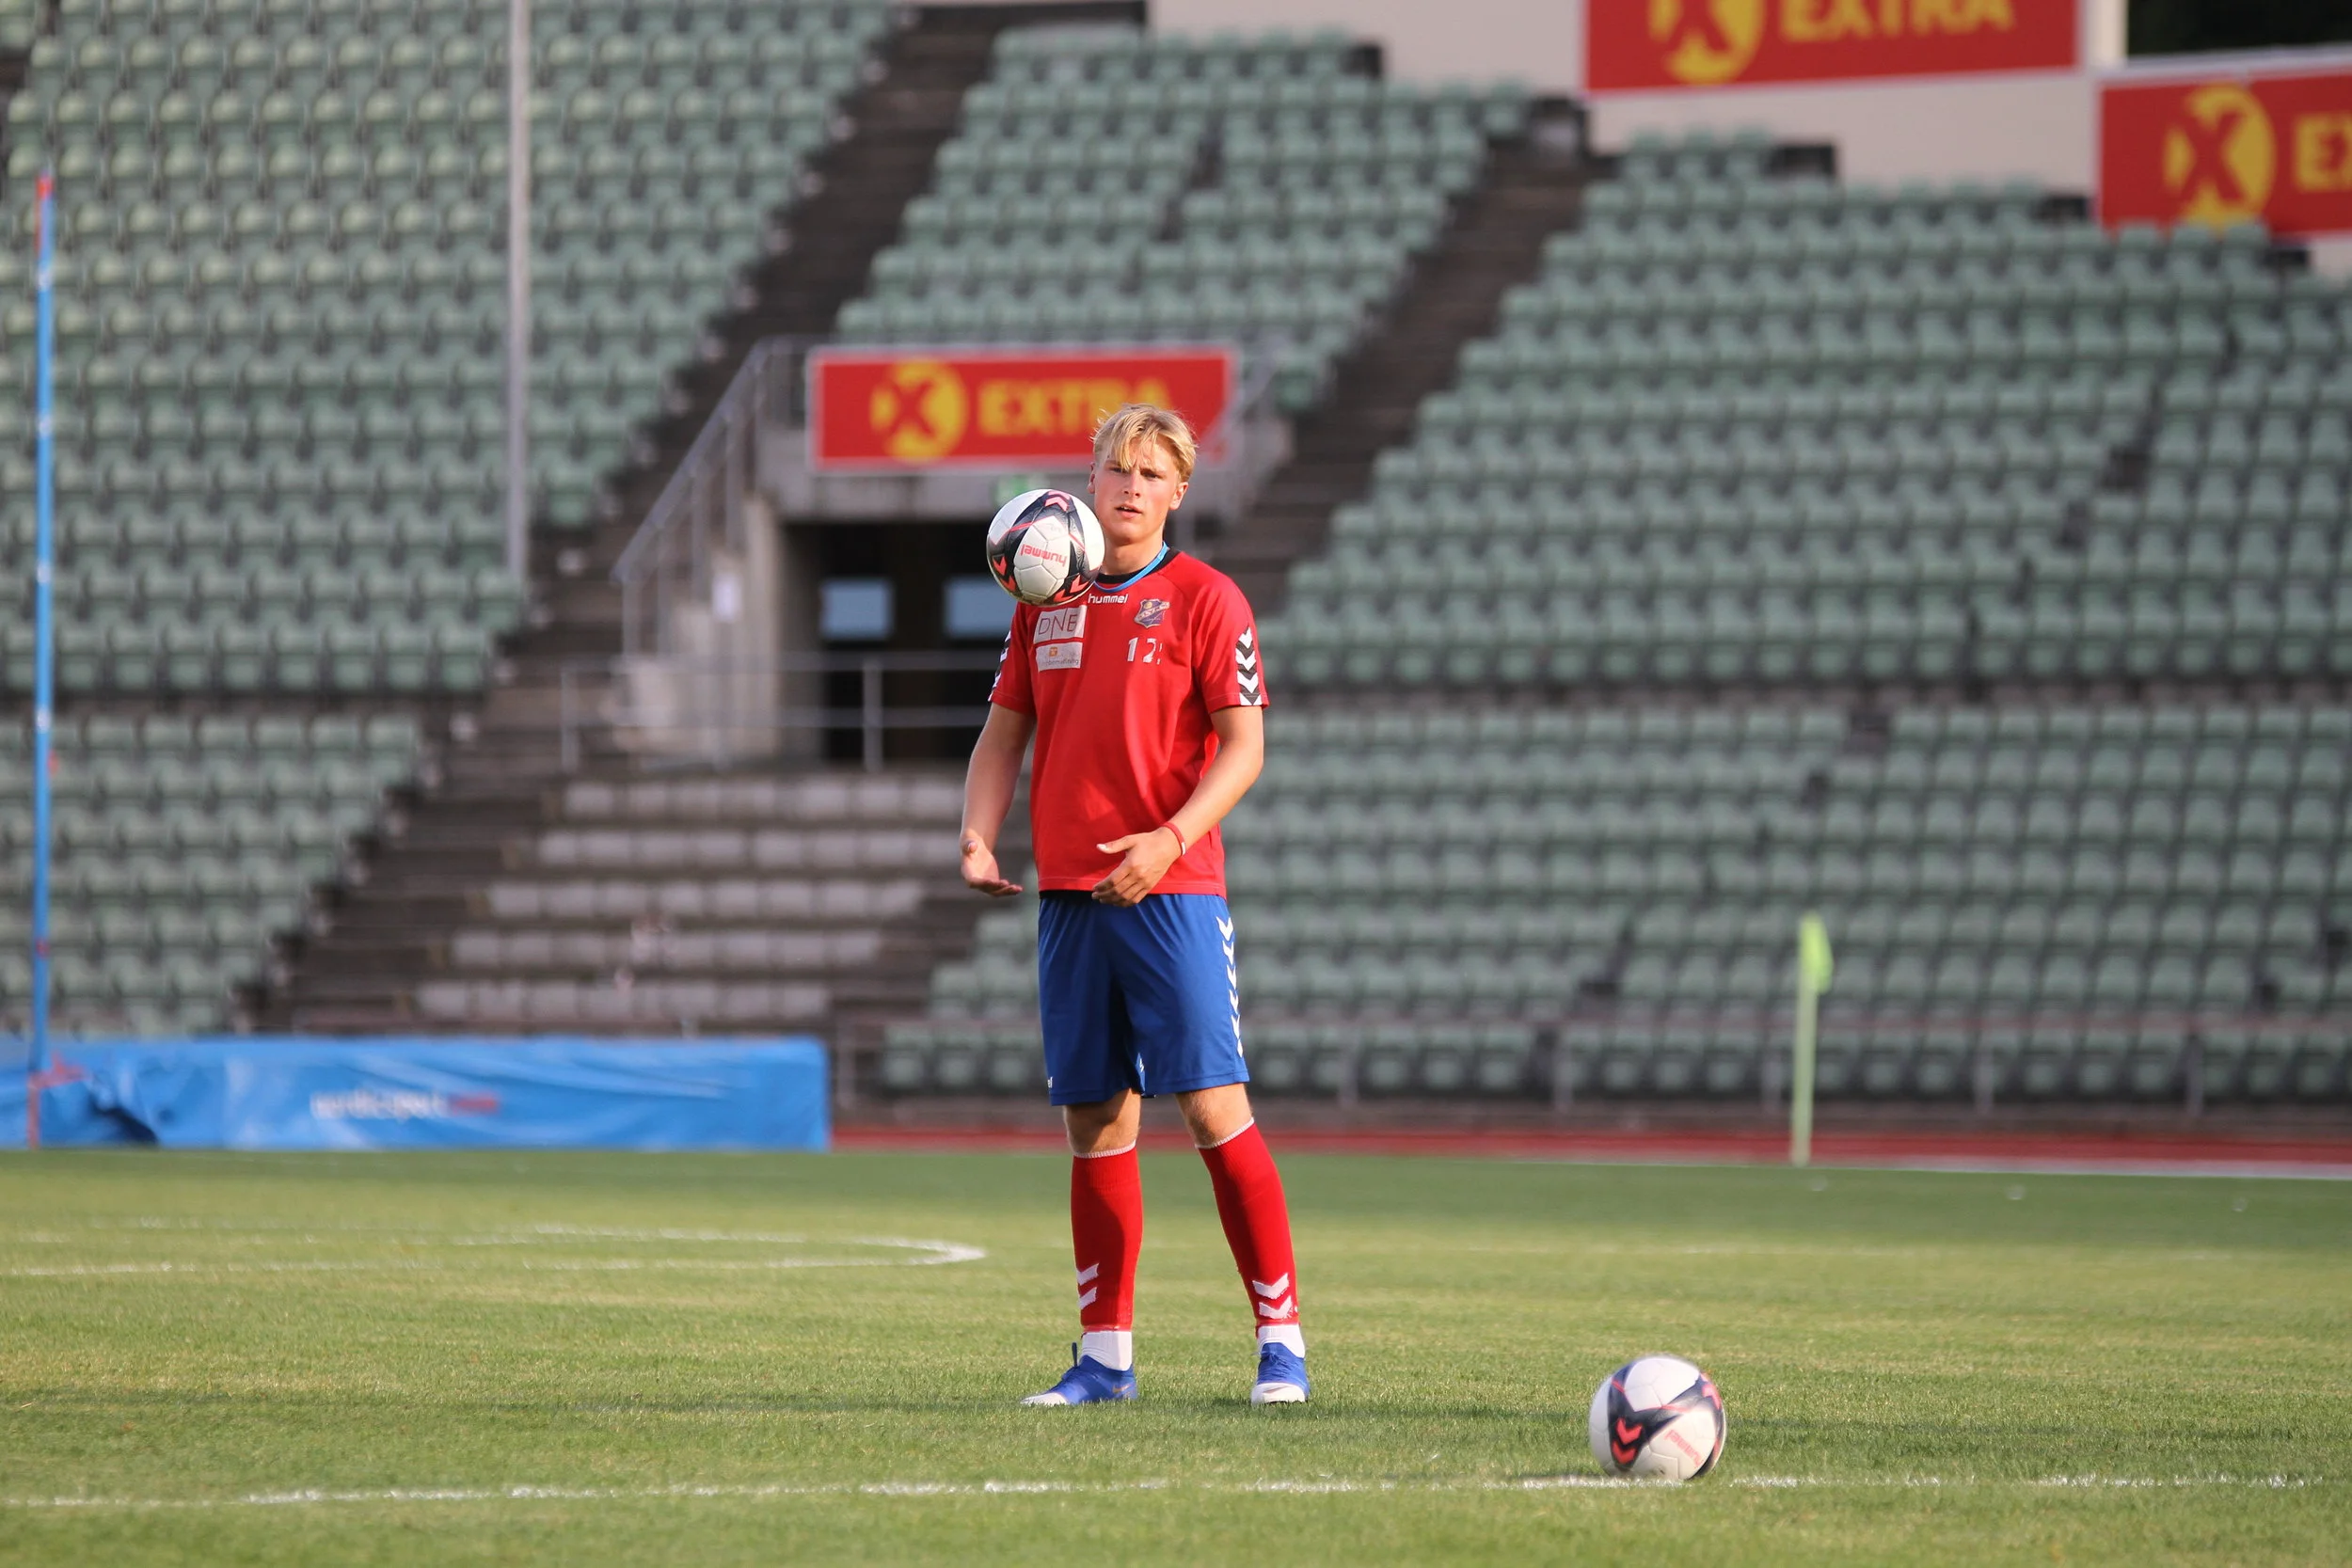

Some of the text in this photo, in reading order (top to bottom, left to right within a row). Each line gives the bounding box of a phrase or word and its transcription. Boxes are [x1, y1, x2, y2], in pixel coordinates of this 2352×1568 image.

[2293, 114, 2352, 190] E
[1020, 544, 1067, 567] hummel
[1088, 593, 1129, 604] hummel
